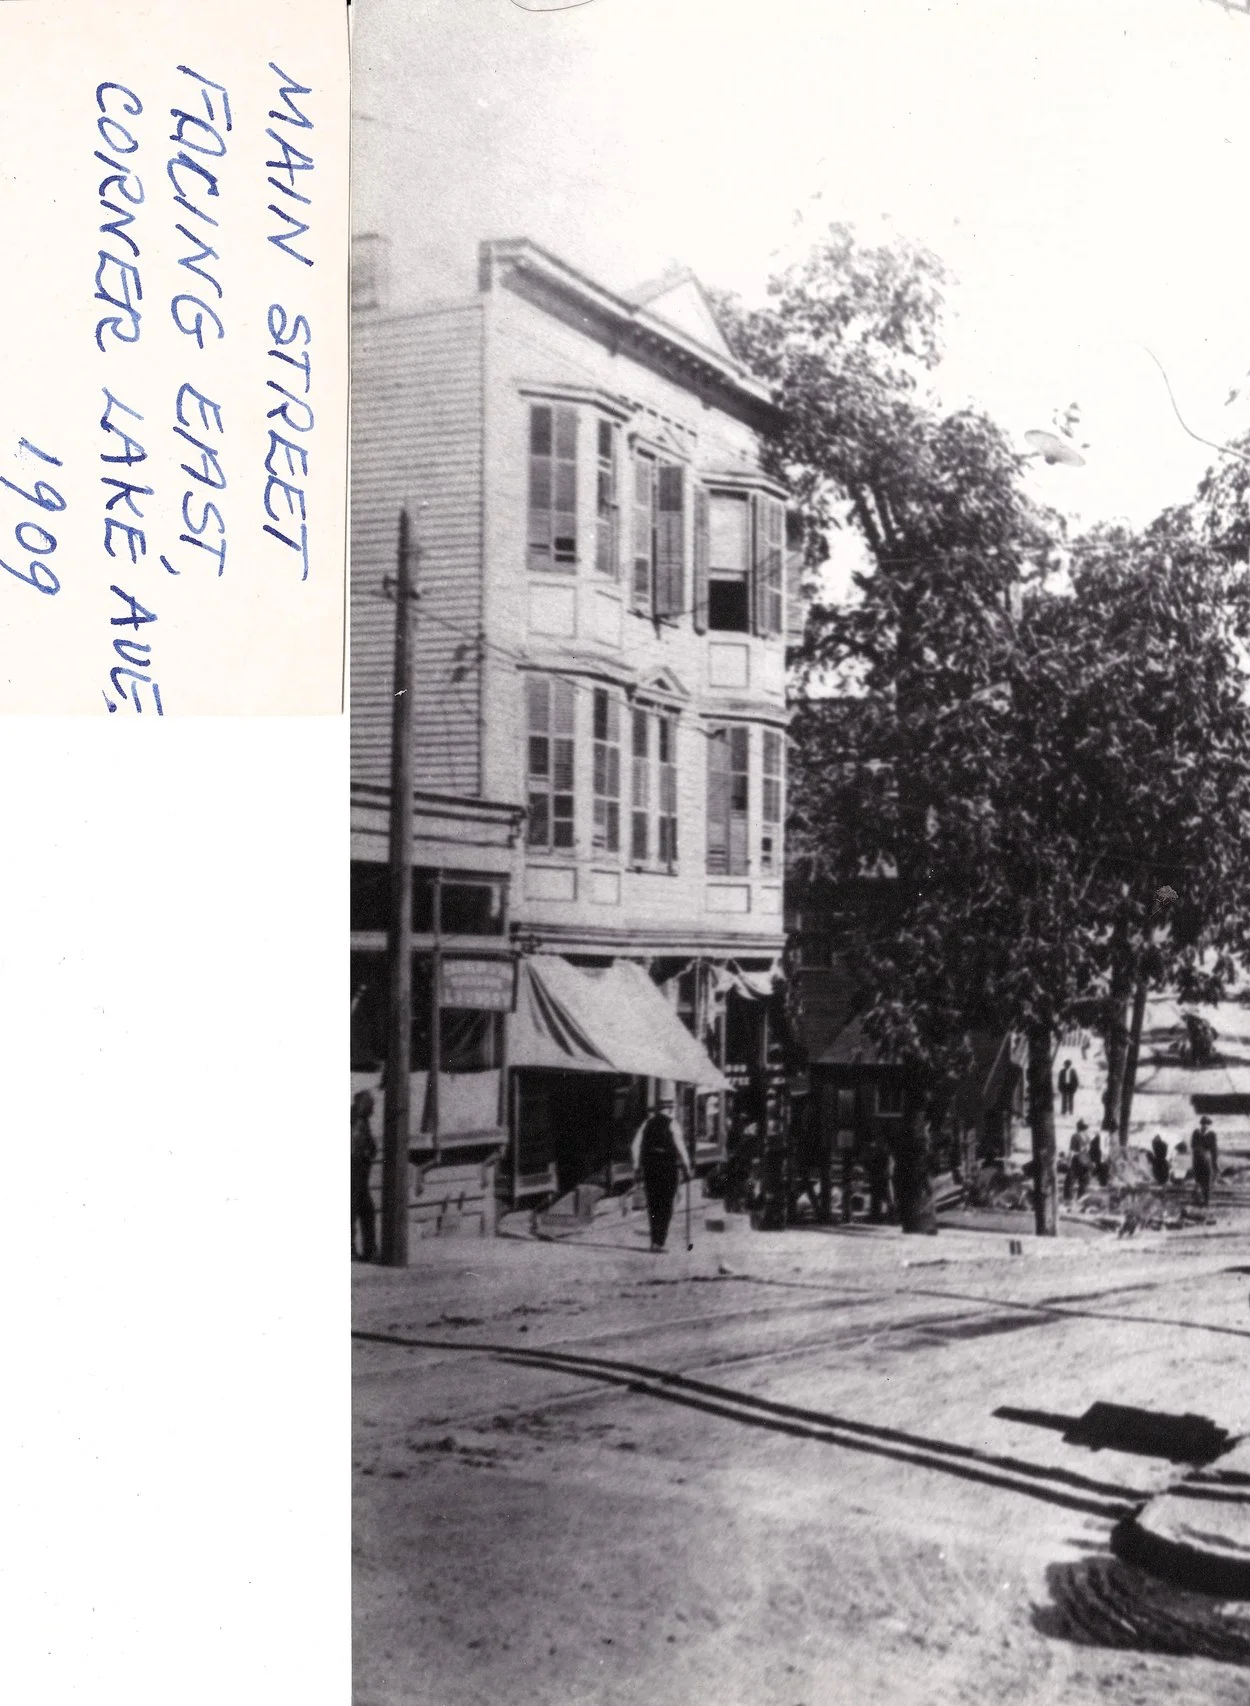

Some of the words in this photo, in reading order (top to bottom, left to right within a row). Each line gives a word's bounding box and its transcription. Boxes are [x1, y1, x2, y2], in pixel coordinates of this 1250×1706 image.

[96, 83, 144, 351] CORNER
[166, 65, 232, 348] FACING
[267, 64, 313, 265] MAIN
[0, 440, 65, 595] 1909
[101, 389, 152, 560] LAKE
[160, 384, 226, 575] EAST,
[265, 304, 314, 580] STREET
